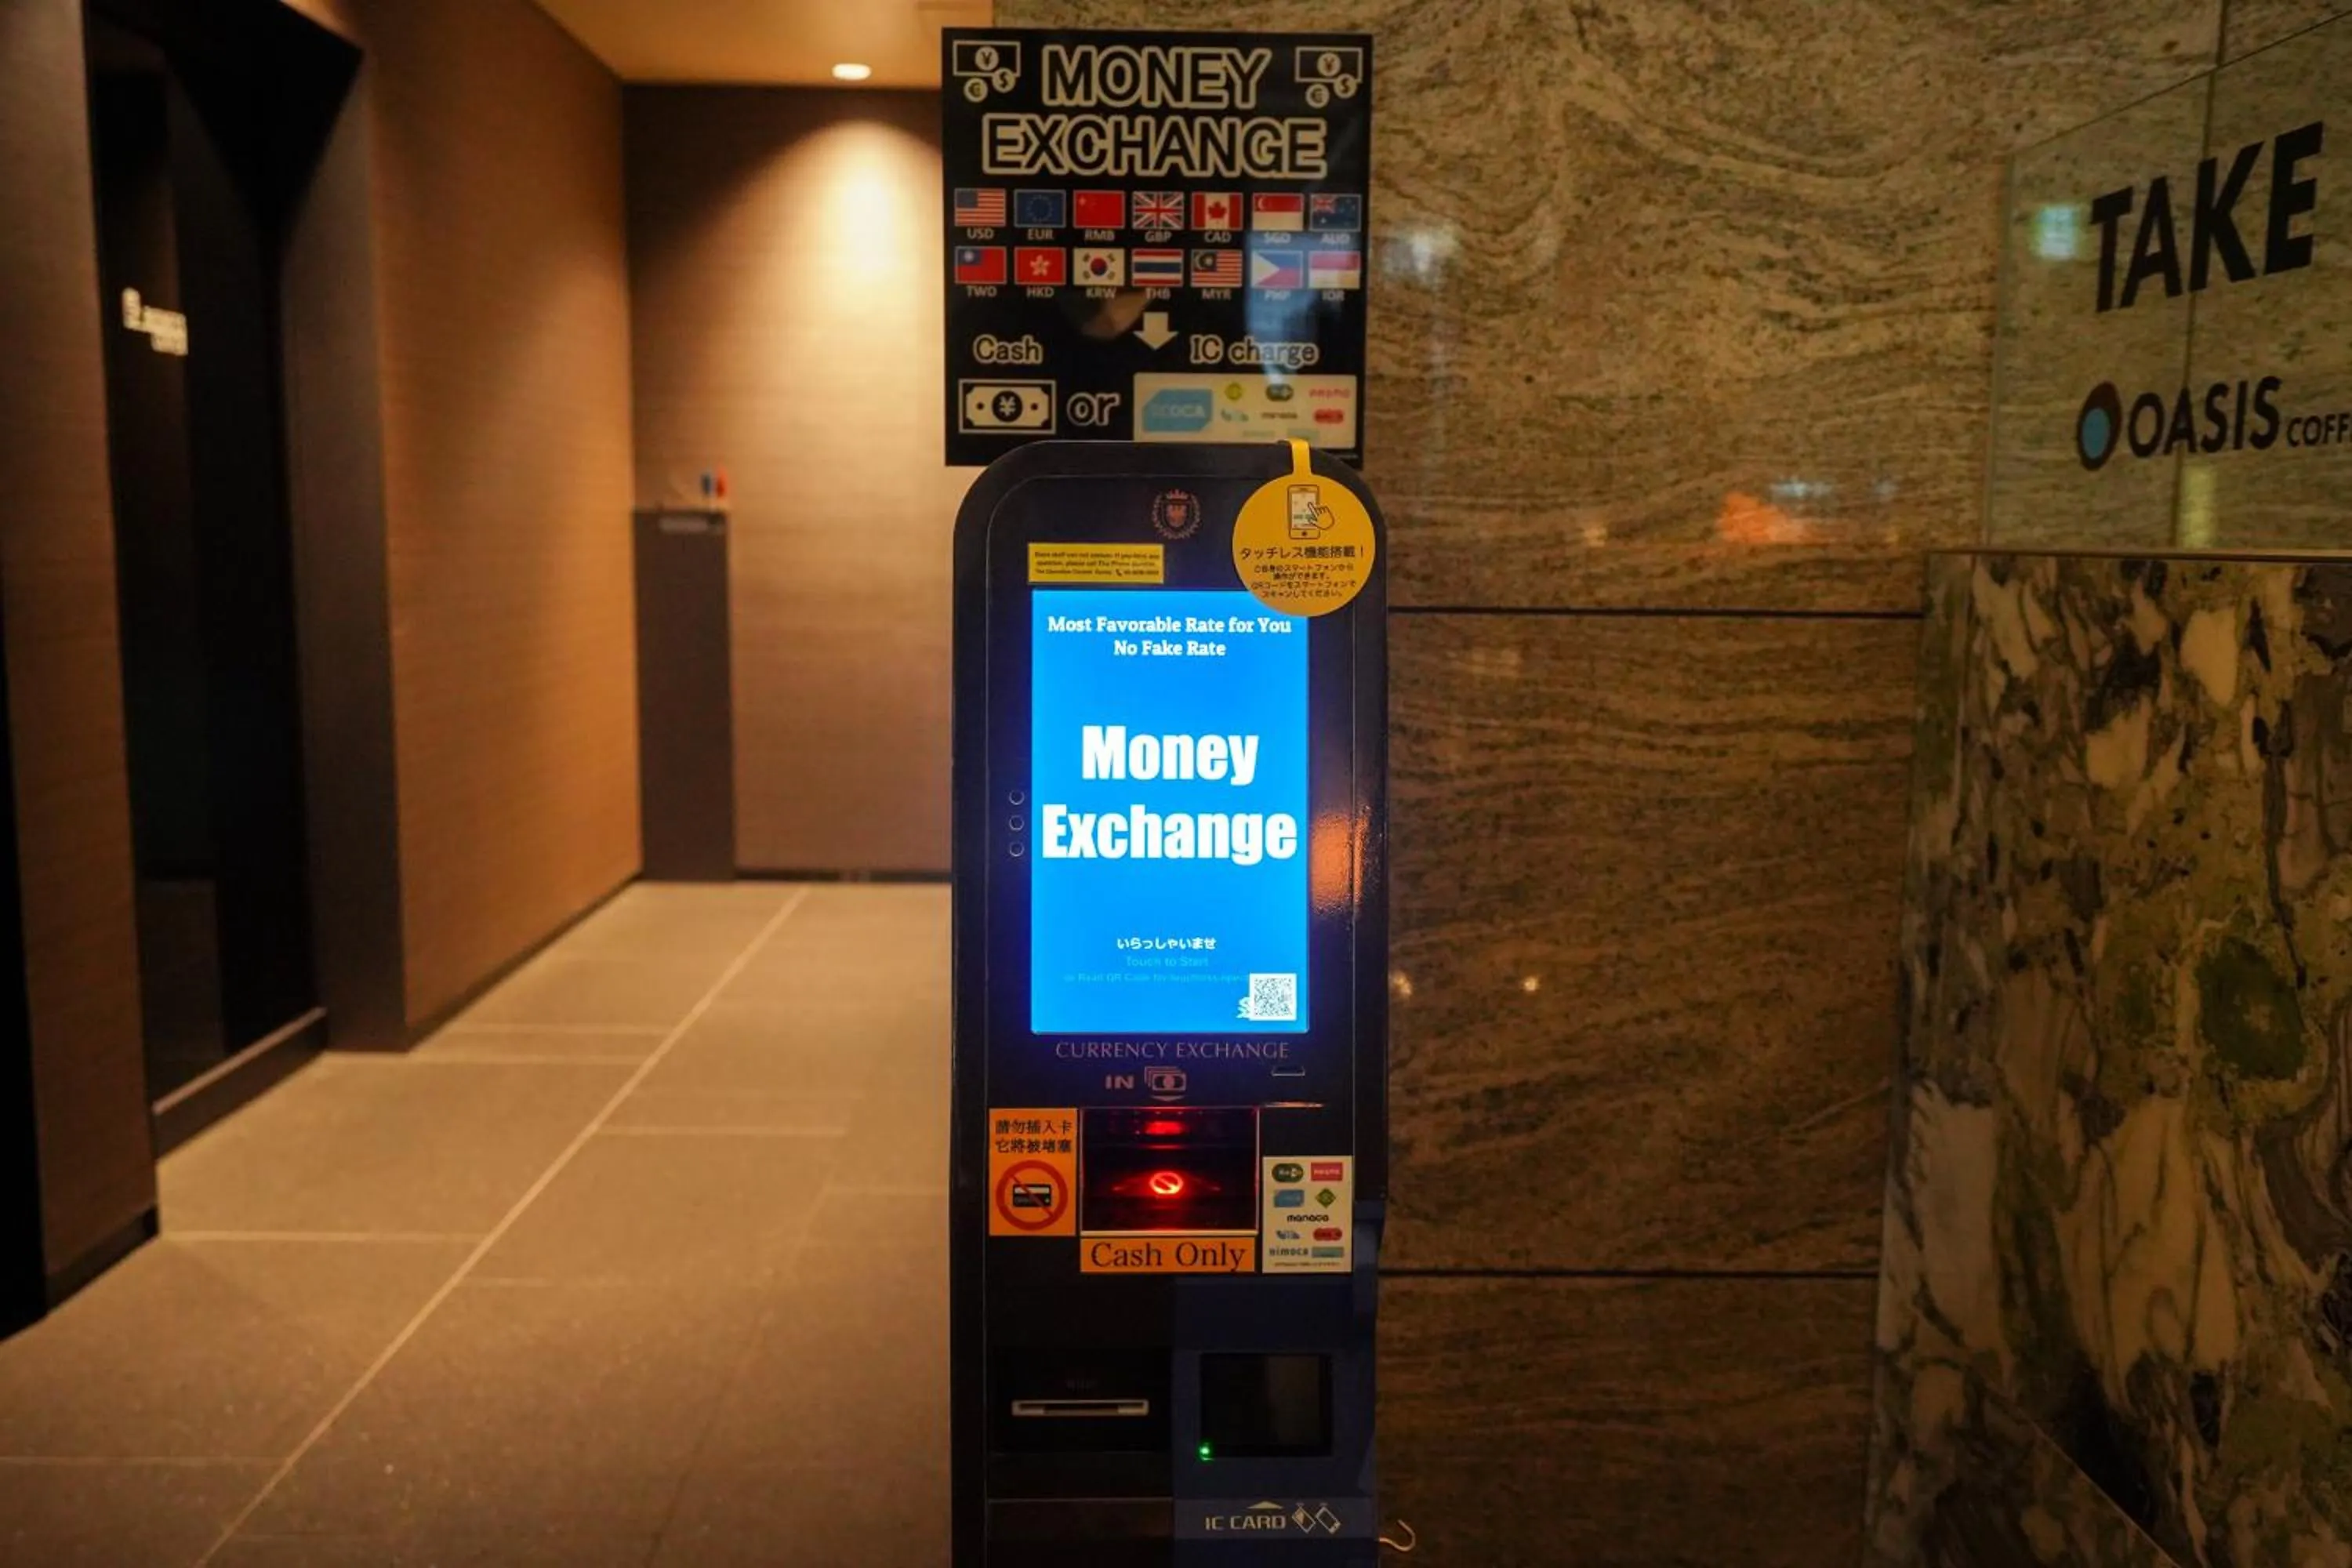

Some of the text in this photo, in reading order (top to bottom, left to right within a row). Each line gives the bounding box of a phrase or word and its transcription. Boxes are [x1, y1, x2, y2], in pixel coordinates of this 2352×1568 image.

[1042, 44, 1272, 109] MONEY
[982, 113, 1327, 178] EXCHANGE
[2090, 121, 2324, 313] TAKE
[967, 228, 994, 240] USD
[1028, 229, 1054, 240] EUR
[1084, 230, 1115, 241] RMB
[1145, 230, 1171, 243] GBP
[1204, 231, 1231, 243] CAD
[967, 286, 996, 297] TWD
[1027, 287, 1054, 298] HKD
[1086, 288, 1116, 299] KRW
[1145, 288, 1171, 299] THB
[1202, 288, 1231, 299] MYR
[973, 335, 1044, 365] Cash
[1190, 336, 1319, 368] IC charge
[1066, 392, 1120, 427] or
[2128, 376, 2352, 458] OASIS COFF
[1047, 616, 1292, 633] Most Favorable Rate for You
[1113, 639, 1226, 656] No Fake Rate
[1082, 725, 1258, 786] Money
[1042, 804, 1298, 866] Exchange
[1117, 938, 1217, 950] いらっしゃいませ
[1127, 956, 1161, 967] Touch
[1165, 956, 1177, 967] to
[1056, 1042, 1290, 1059] CURRENCY EXCHANGE
[1105, 1075, 1134, 1089] IN
[1091, 1241, 1245, 1272] Cash Only
[1205, 1515, 1286, 1530] IC CARD
